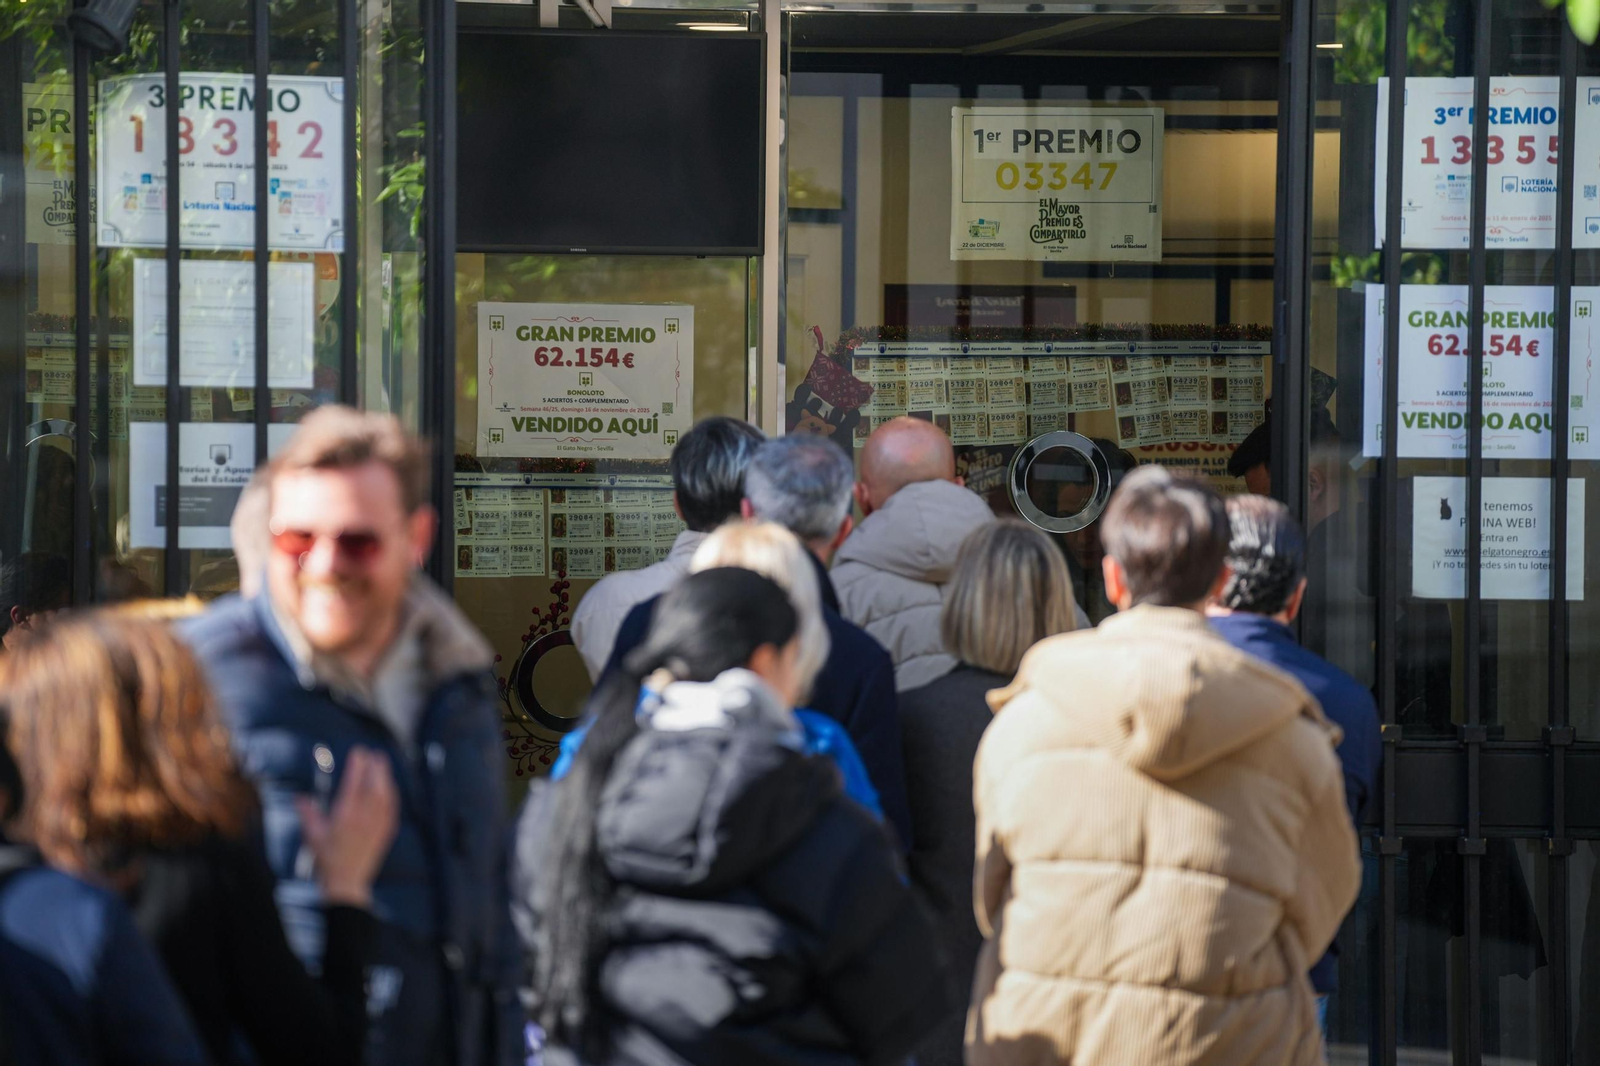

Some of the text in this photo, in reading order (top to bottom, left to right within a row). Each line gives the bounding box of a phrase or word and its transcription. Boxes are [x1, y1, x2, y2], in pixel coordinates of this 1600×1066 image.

[1434, 107, 1463, 125] 3er
[974, 129, 1141, 153] 1er PREMIO
[996, 162, 1118, 190] 03347
[1521, 177, 1553, 185] LOTERÍA
[1039, 199, 1049, 207] EL
[1408, 310, 1470, 328] GRAN
[516, 325, 656, 343] GRAN PREMIO
[511, 413, 658, 436] VENDIDO AQUÍ
[1484, 501, 1533, 512] tenemos
[1506, 518, 1536, 528] WEB!
[1506, 535, 1518, 543] en
[1503, 561, 1516, 570] sin
[1518, 562, 1528, 570] tu
